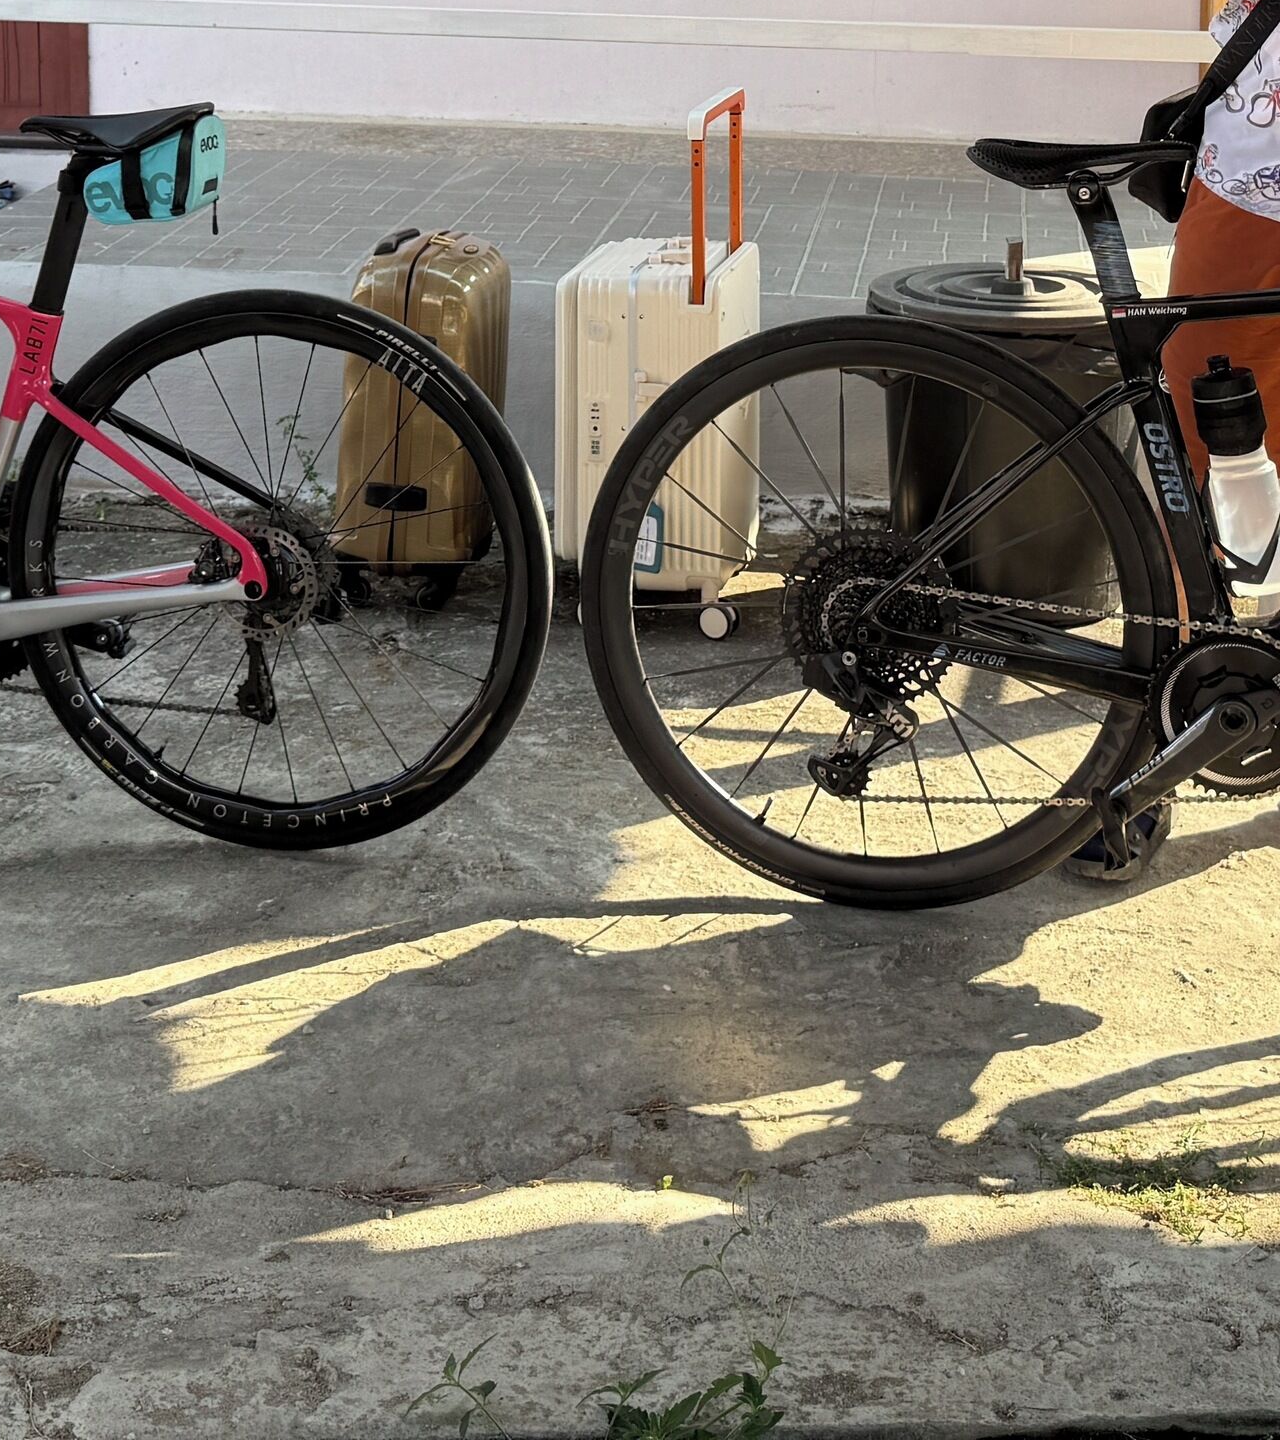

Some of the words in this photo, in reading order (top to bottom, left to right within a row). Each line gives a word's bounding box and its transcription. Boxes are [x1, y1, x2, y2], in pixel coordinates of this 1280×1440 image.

[85, 172, 174, 213] evc
[1127, 307, 1146, 317] HAN
[375, 329, 438, 371] PIRELLI
[1143, 422, 1190, 513] OSTRO
[954, 648, 1007, 667] FACTOR
[55, 669, 159, 785] CARBON
[186, 792, 393, 829] PRINCETON
